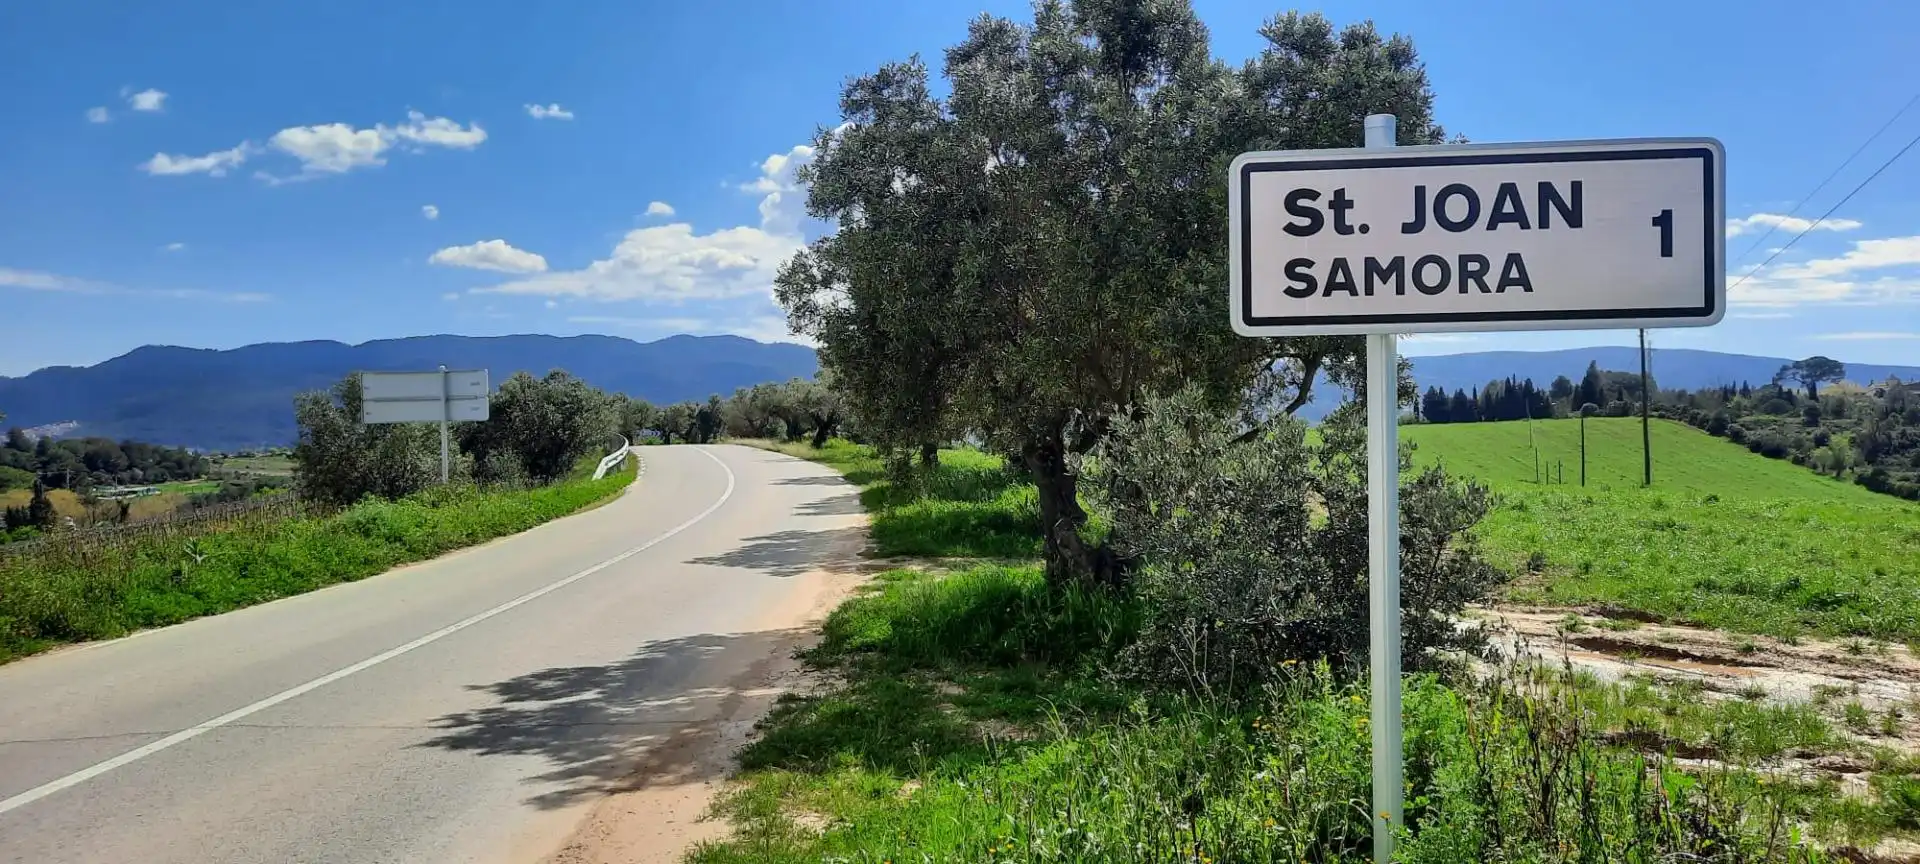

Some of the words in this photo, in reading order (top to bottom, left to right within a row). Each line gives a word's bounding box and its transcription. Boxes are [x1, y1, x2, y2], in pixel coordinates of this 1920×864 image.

[1282, 187, 1370, 238] St.
[1400, 180, 1583, 235] JOAN
[1651, 208, 1674, 258] 1
[1282, 252, 1534, 299] SAMORA
